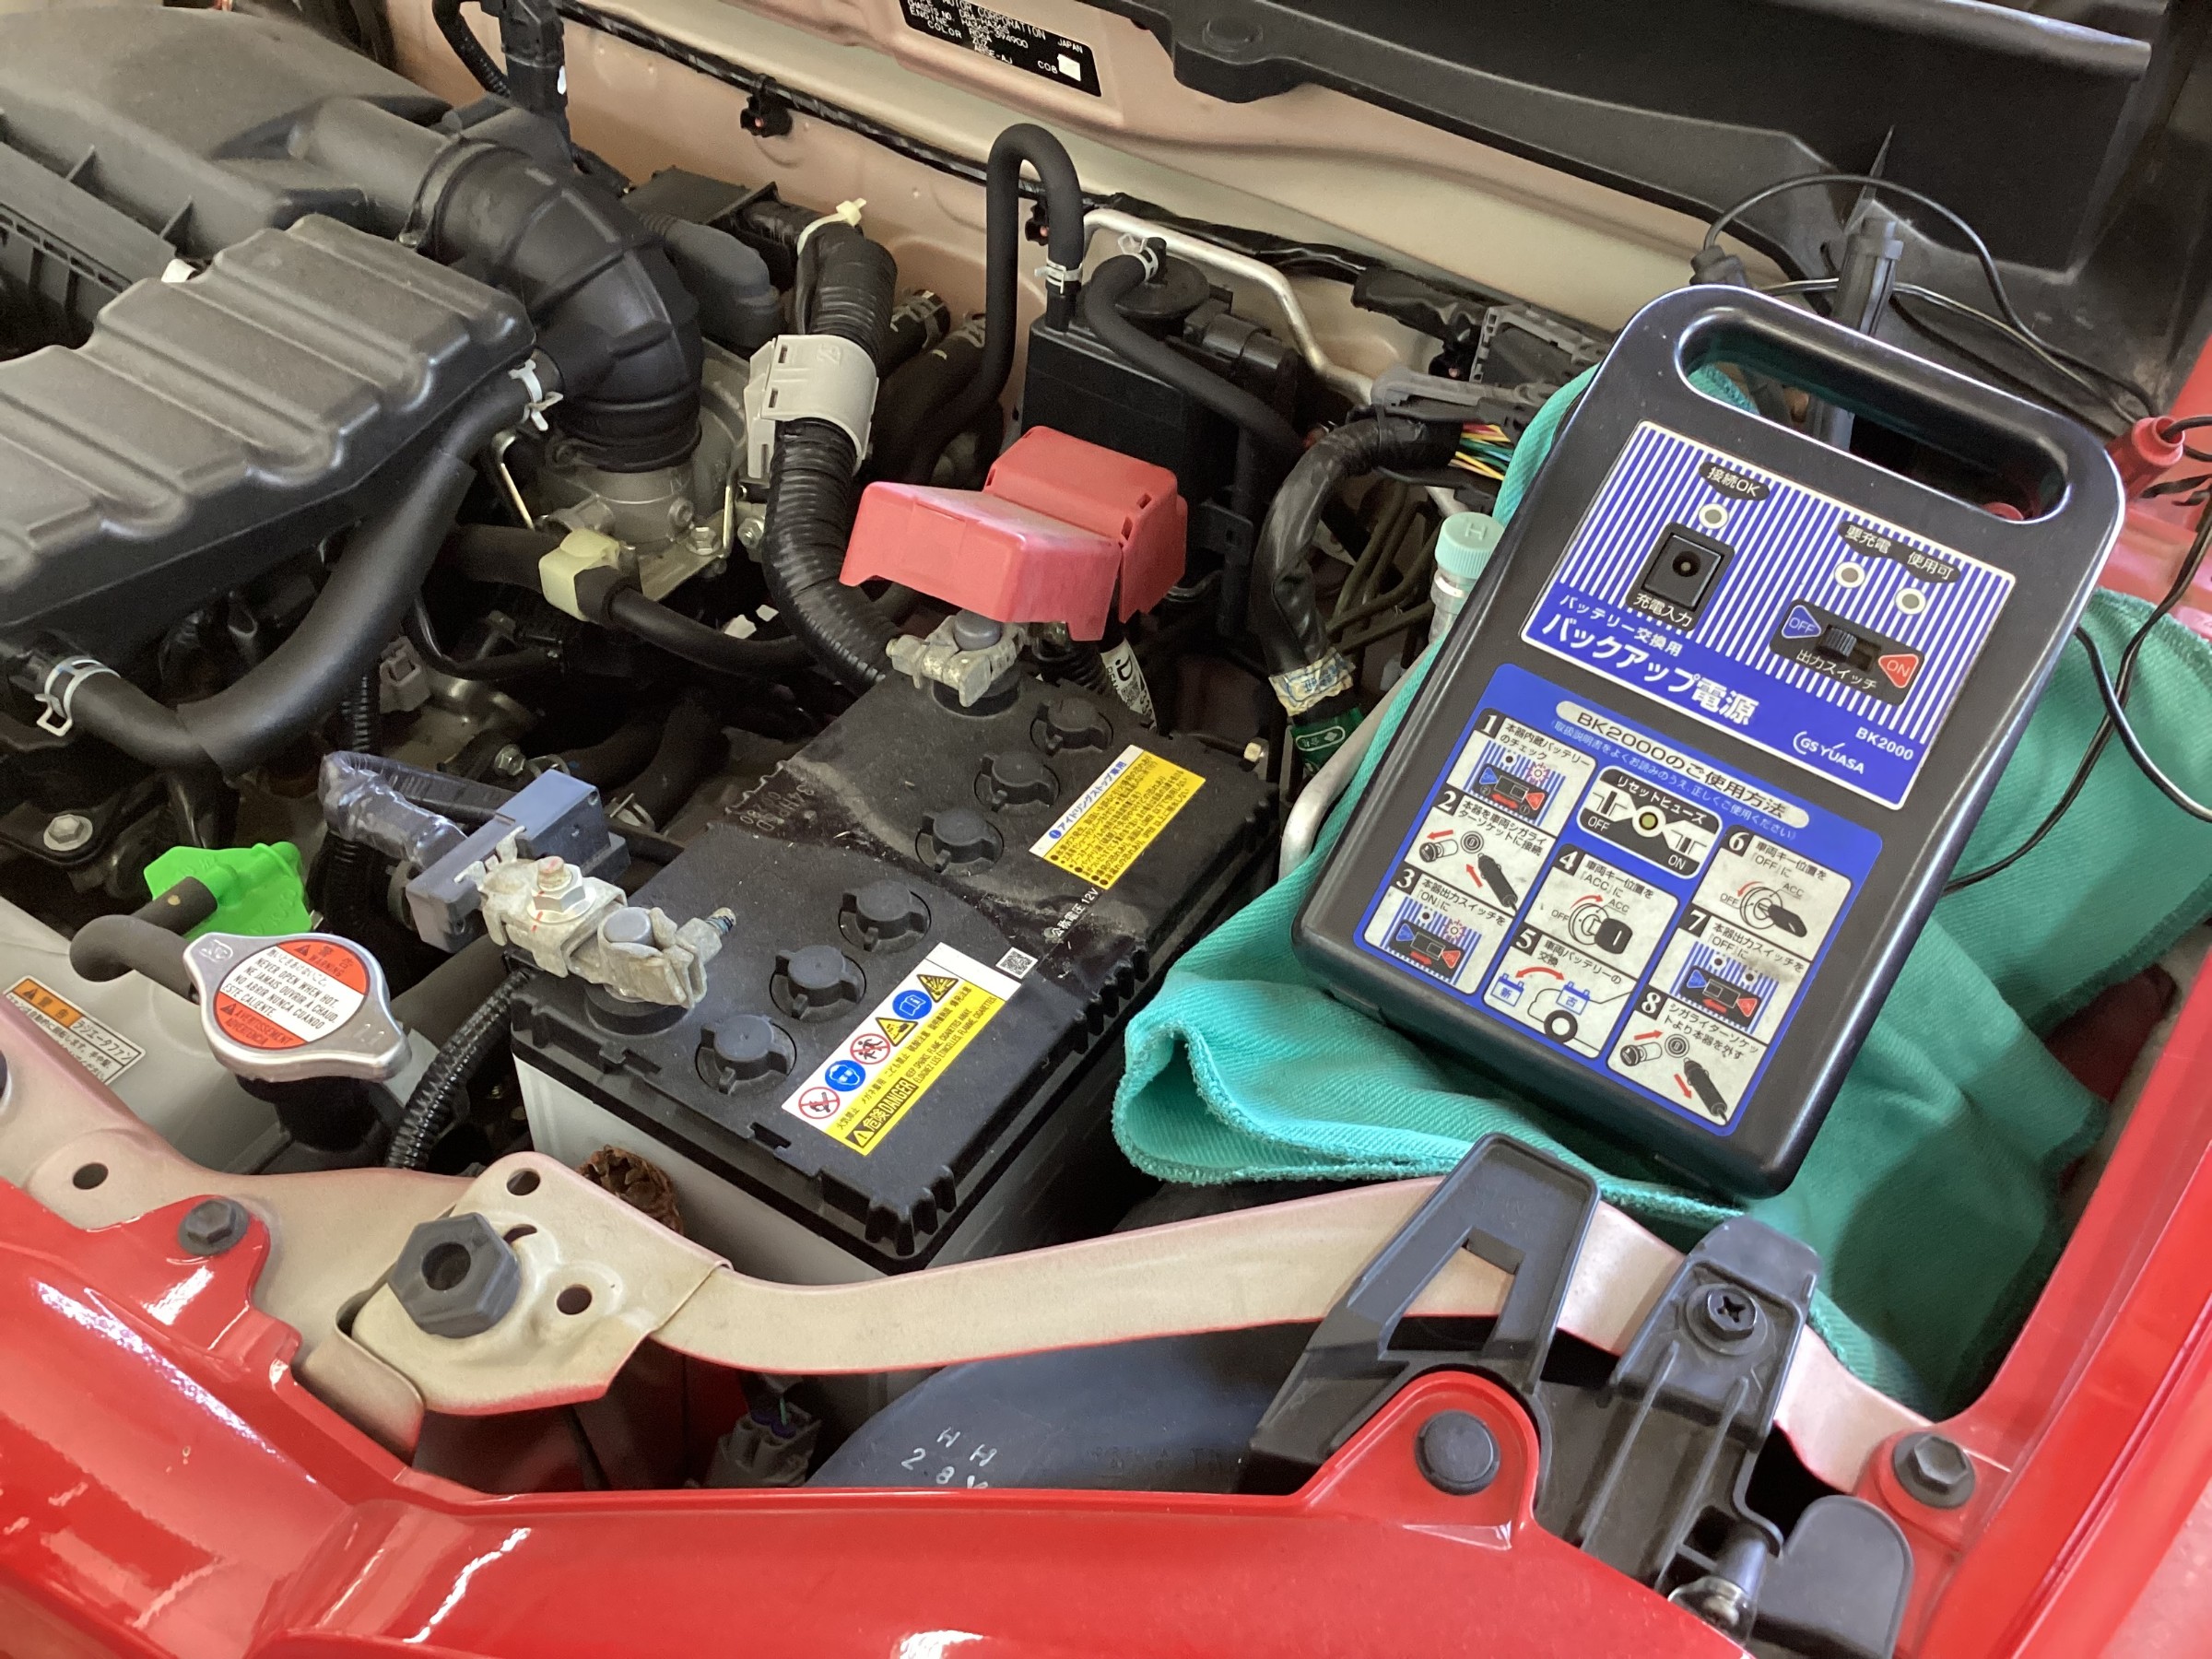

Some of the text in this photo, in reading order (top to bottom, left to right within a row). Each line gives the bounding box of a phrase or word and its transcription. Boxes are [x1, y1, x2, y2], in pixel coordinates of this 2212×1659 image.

[910, 6, 949, 27] ENGINE
[927, 19, 962, 39] COLOR
[978, 6, 1046, 41] CORPORATION
[1057, 38, 1083, 53] JAPAN
[1707, 465, 1759, 498] 接続OK
[1846, 524, 1892, 554] 要充電
[1907, 550, 1955, 580] 使用可
[1633, 592, 1692, 628] 充電入力
[1559, 594, 1684, 658] バッテリー交換用
[1789, 617, 1816, 634] OFF
[1543, 614, 1759, 726] バックアップ電源
[1796, 649, 1877, 689] 出力スイッチ
[1887, 659, 1911, 677] ON
[1483, 714, 1498, 735] 1
[1499, 735, 1547, 760] のチェック
[1855, 726, 1914, 761] BK2000
[1577, 712, 1787, 818] BK2000のご使用方法
[1057, 760, 1127, 830] アイドリングストップ車用
[1438, 791, 1456, 811] 2
[1618, 776, 1707, 825] リセットヒューズ
[1588, 817, 1610, 831] OFF
[1728, 831, 1749, 851] 6
[1559, 851, 1578, 871] 4
[1668, 855, 1686, 870] ON
[1396, 869, 1415, 888] 3
[1783, 882, 1805, 898] ACC
[1081, 887, 1099, 904] 12V
[1421, 879, 1506, 926] 本器出力スイッチを
[1608, 899, 1630, 913] ACC
[1720, 892, 1740, 906] OFF
[1551, 909, 1570, 922] OFF
[1688, 910, 1706, 931] 7
[1516, 929, 1536, 949] 5
[1712, 923, 1805, 973] 本器出力スイッチを
[309, 954, 345, 977] WARNING
[1537, 952, 1559, 968] 交換
[1544, 939, 1622, 984] 車両バッテリーの
[242, 966, 257, 975] NE
[253, 971, 283, 989] JAMAIS
[277, 985, 308, 1004] OUVRIR
[310, 1004, 341, 1023] CHAUD.
[253, 957, 341, 1008] NEVER OPEN WHEN HOT.
[221, 982, 278, 1018] ESTE CALIENTE.
[232, 974, 325, 1030] NO ABRIR NUNCA CUANDO
[1565, 996, 1578, 1008] 古
[1641, 992, 1661, 1014] 8
[73, 1019, 133, 1061] ラジエータファン
[1664, 1016, 1744, 1059] トより本器を外す
[1668, 1003, 1759, 1053] シガライターソケッ
[862, 1079, 916, 1131] 危険 DANGER
